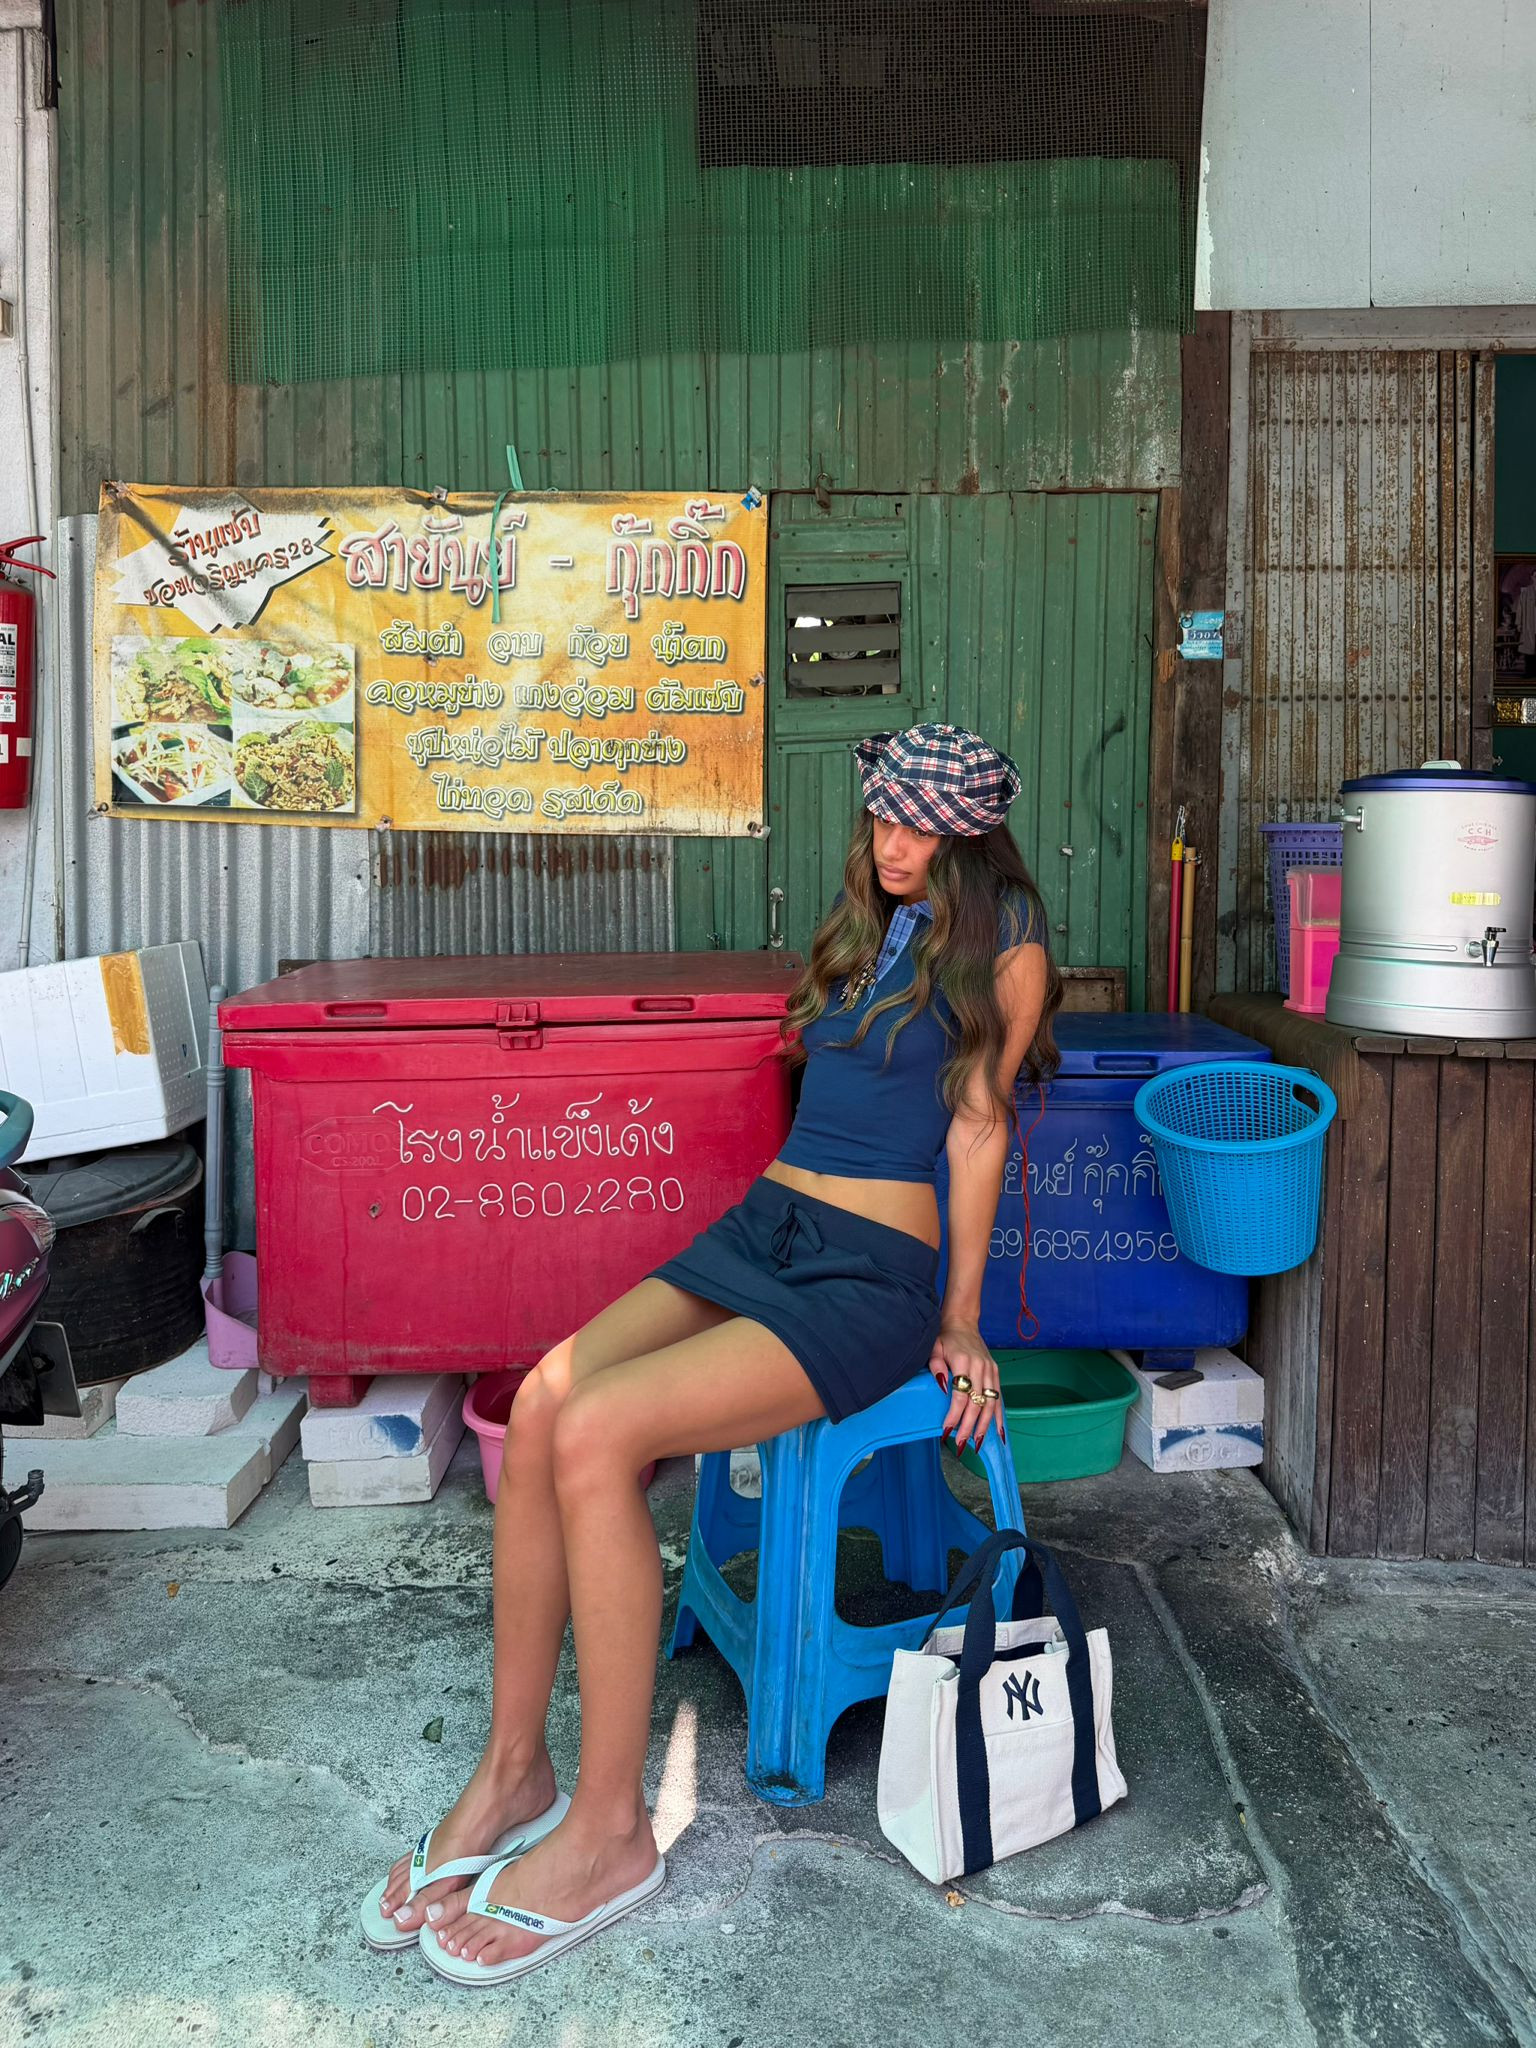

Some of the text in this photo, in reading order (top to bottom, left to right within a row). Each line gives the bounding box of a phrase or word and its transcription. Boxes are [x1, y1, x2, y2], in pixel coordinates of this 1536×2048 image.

[549, 556, 573, 566] -
[606, 498, 746, 618] กุ๊กกิ๊ก
[381, 619, 727, 666] ส้มตำ ลาบ ก้อย น้ำตก
[366, 674, 503, 715] คอหมูย่าง
[514, 677, 635, 718] แกงอ่อม
[405, 723, 686, 771] ซุปหน่อไม้ ปลาดุกย่าง
[431, 772, 643, 819] ไก่ทอด รสเด็ด
[402, 1176, 685, 1222] 02-8602280
[1002, 1669, 1043, 1721] NY
[499, 1906, 545, 1930] havaianas
